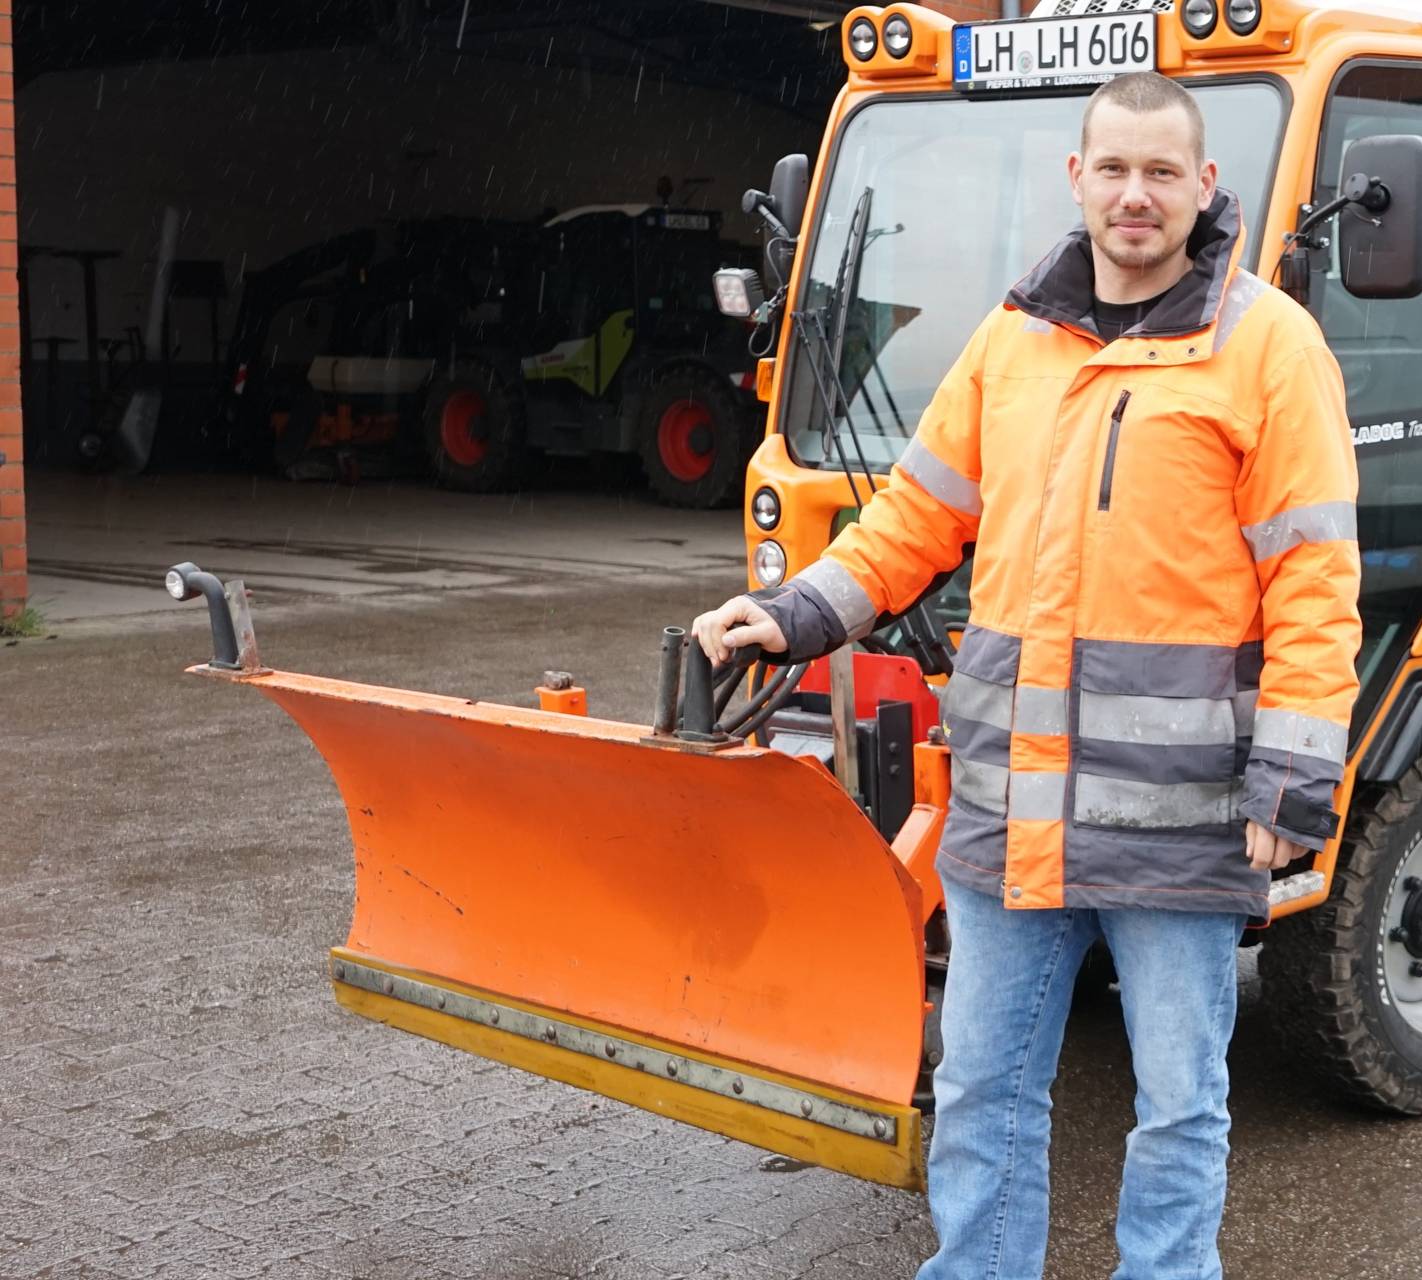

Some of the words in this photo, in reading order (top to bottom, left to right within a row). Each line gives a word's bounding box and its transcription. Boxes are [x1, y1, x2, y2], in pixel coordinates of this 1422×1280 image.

[975, 31, 1013, 73] LH
[1038, 26, 1078, 69] LH
[1089, 21, 1149, 66] 606
[959, 60, 968, 73] D
